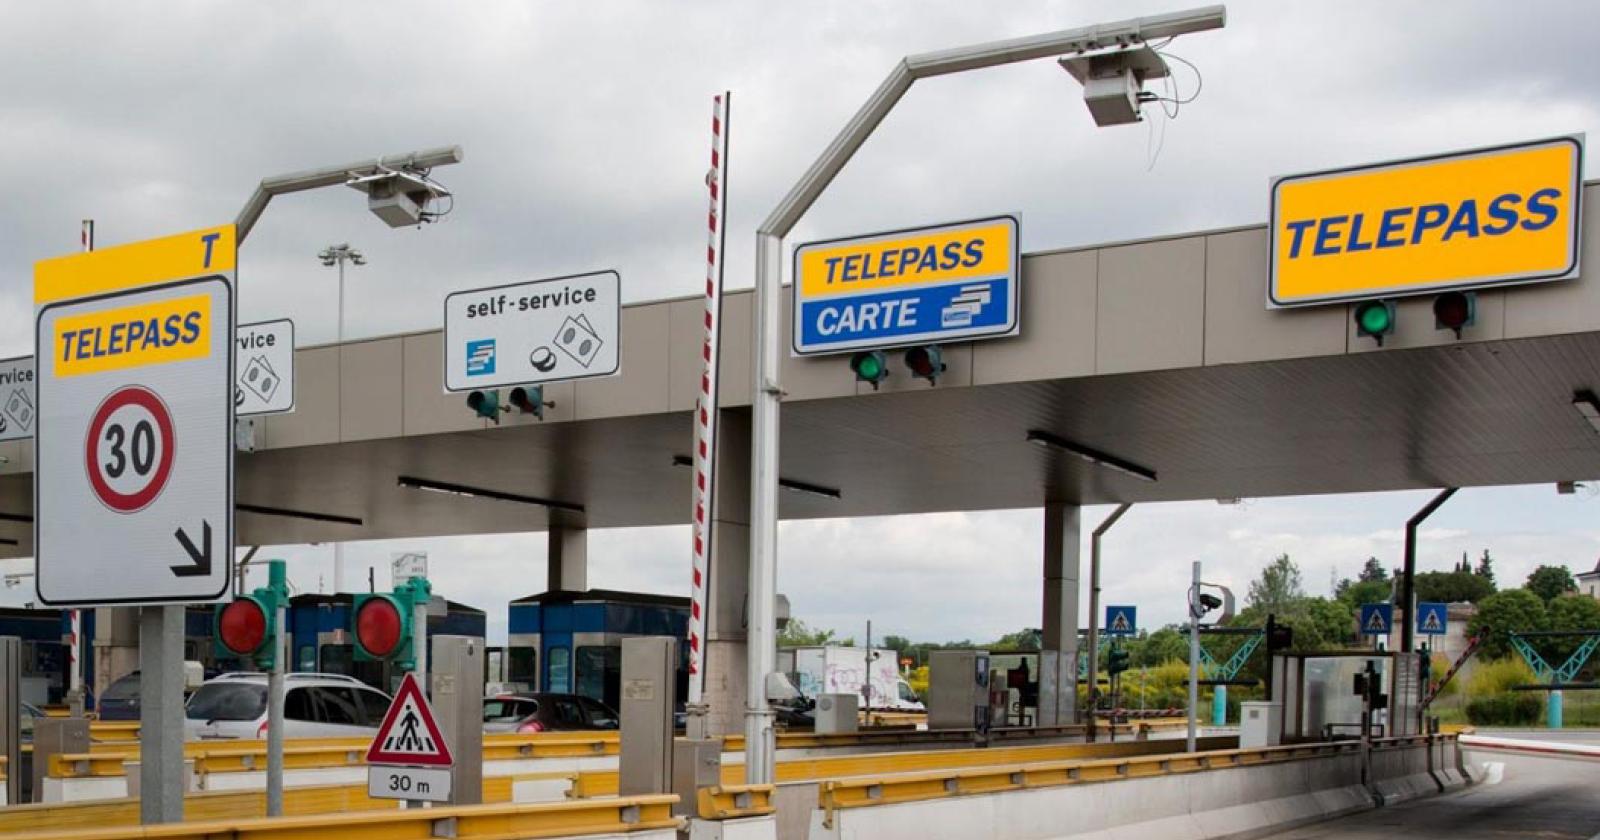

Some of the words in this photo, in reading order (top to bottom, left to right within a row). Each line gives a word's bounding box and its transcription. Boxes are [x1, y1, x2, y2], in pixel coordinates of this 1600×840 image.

[1286, 188, 1562, 259] TELEPASS
[201, 233, 220, 269] T
[825, 239, 985, 285] TELEPASS
[467, 286, 596, 318] self-service
[816, 298, 921, 336] CARTE
[61, 311, 202, 362] TELEPASS
[234, 332, 275, 349] vice
[105, 420, 156, 479] 30
[389, 774, 412, 792] 30
[416, 781, 430, 794] m
